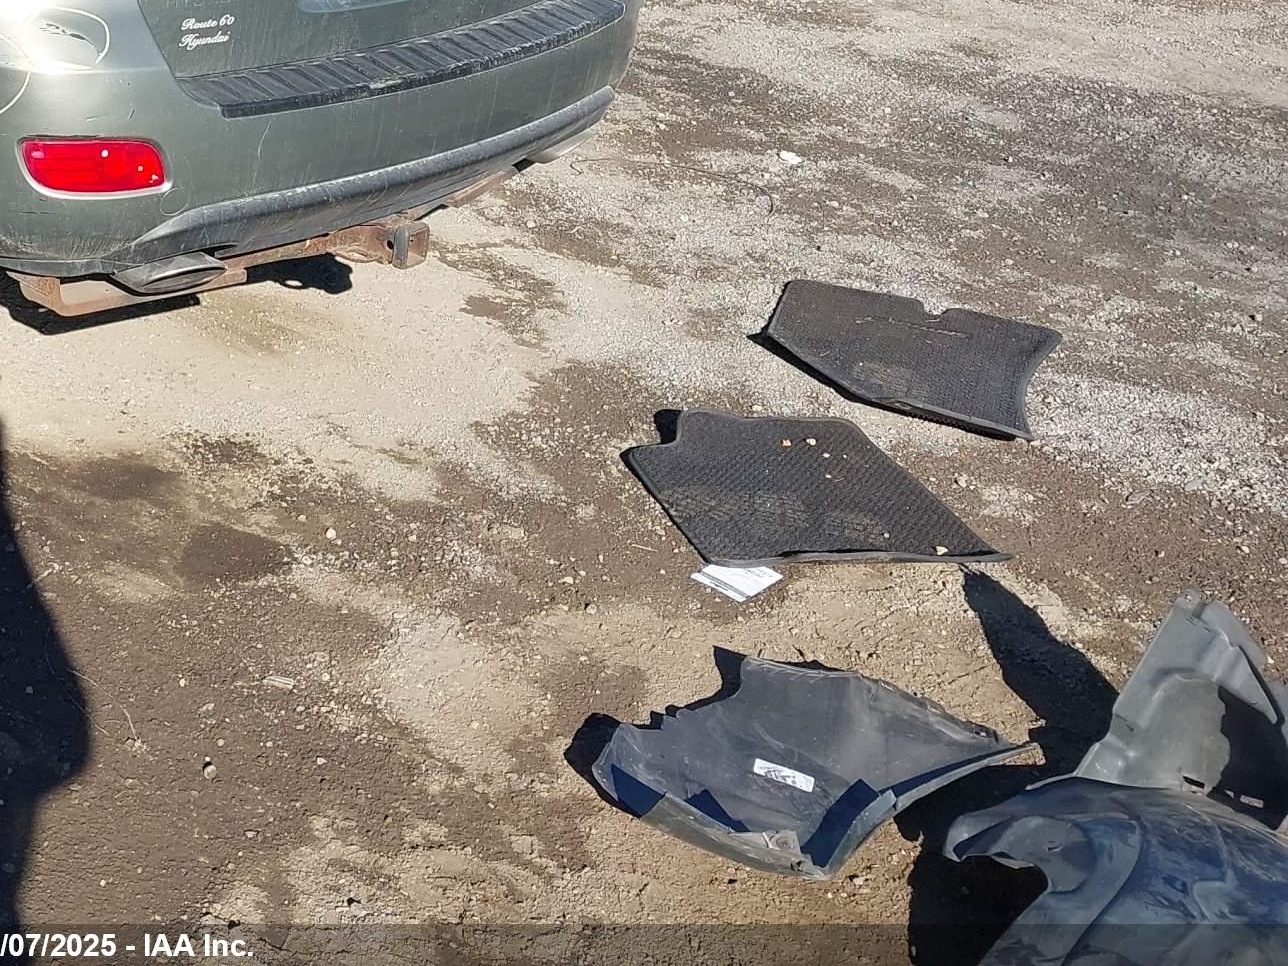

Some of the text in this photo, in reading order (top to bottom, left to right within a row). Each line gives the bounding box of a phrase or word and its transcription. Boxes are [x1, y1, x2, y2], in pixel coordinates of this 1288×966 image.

[180, 14, 235, 31] Route 60
[178, 30, 231, 50] Hyundai
